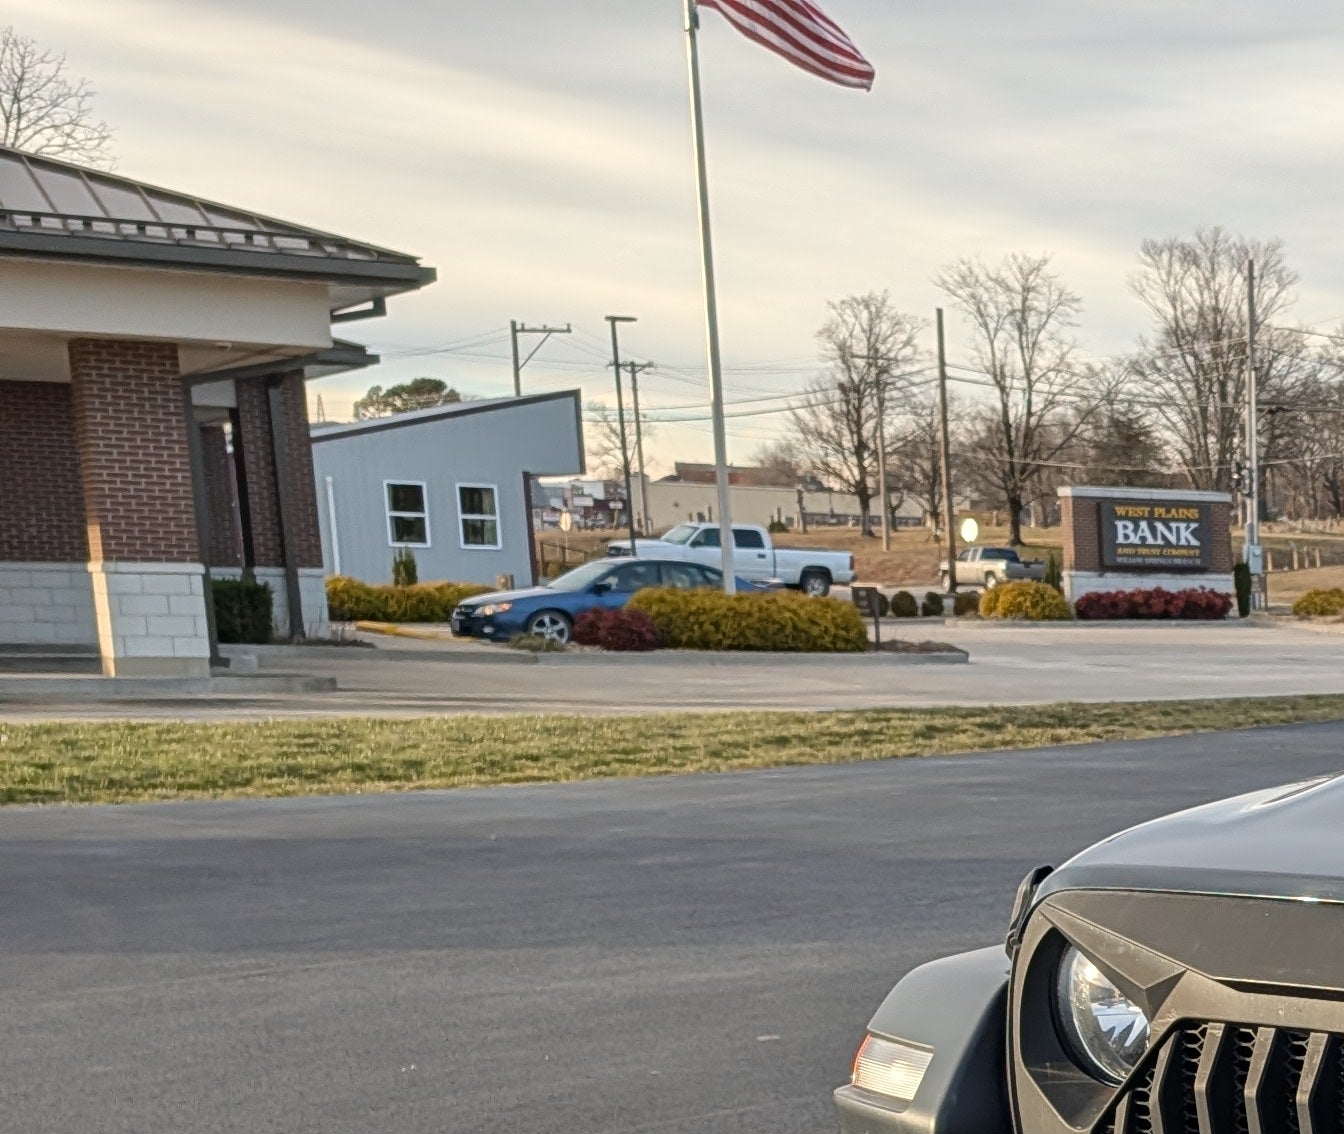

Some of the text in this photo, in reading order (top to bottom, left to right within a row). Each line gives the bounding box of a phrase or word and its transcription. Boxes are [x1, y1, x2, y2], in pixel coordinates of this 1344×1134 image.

[1114, 505, 1199, 519] WEST PLAINS
[1114, 520, 1200, 546] BANK
